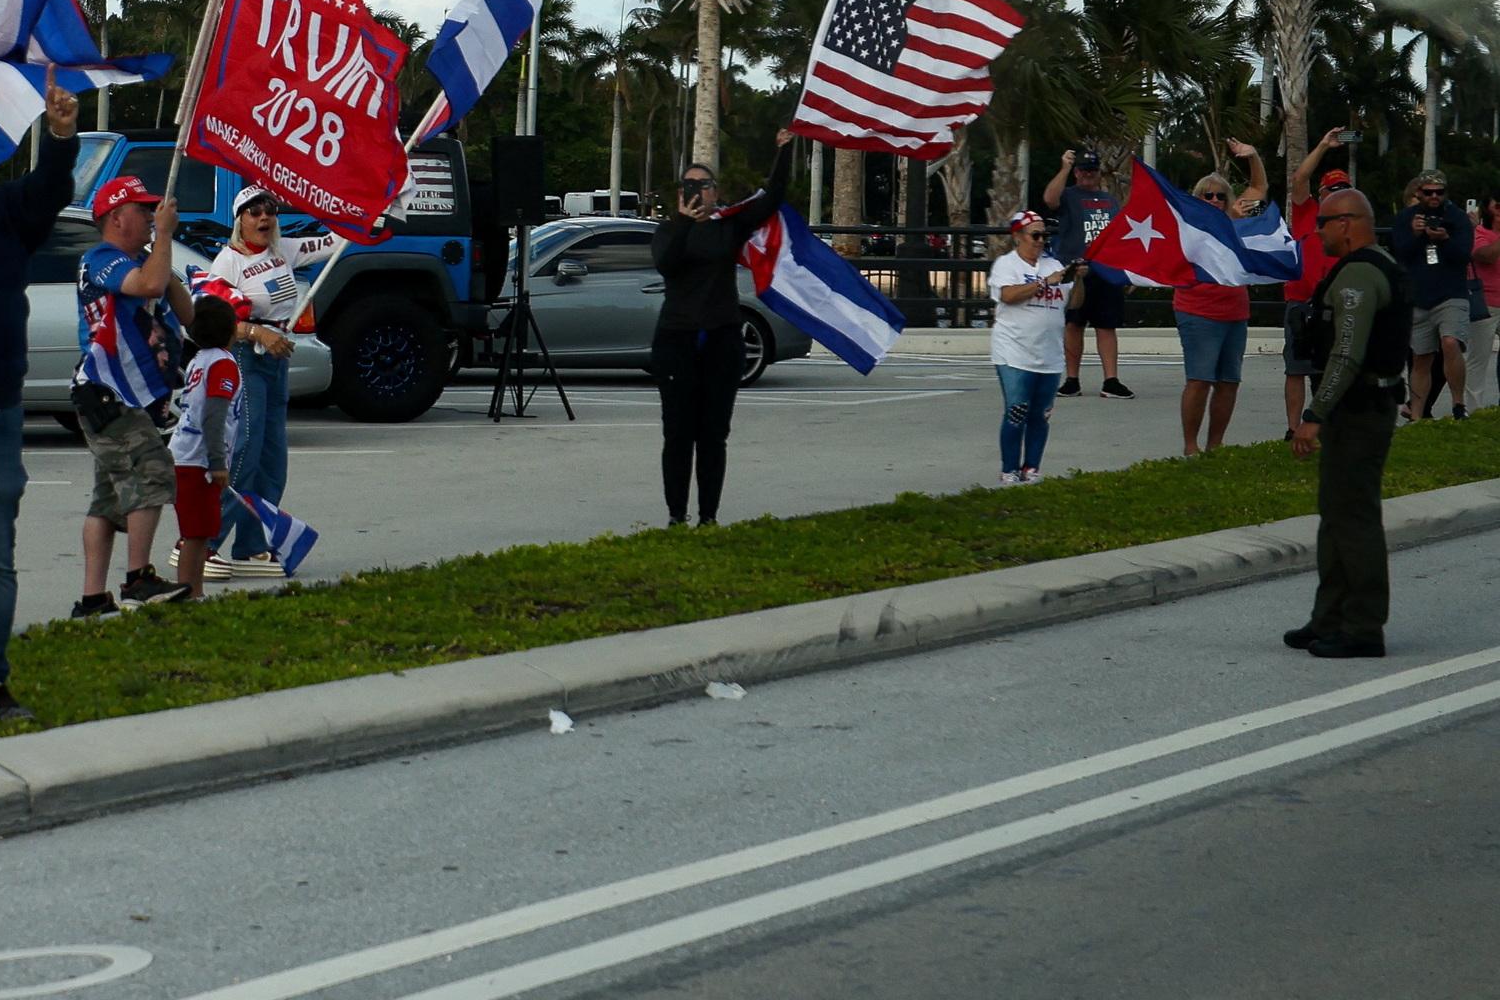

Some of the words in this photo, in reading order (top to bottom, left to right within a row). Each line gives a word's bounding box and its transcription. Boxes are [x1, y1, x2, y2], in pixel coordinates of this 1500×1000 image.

[206, 114, 240, 147] MAKE
[272, 163, 310, 199] GREAT
[252, 77, 346, 167] 2028
[411, 202, 435, 211] YOUR
[435, 202, 453, 211] ASS
